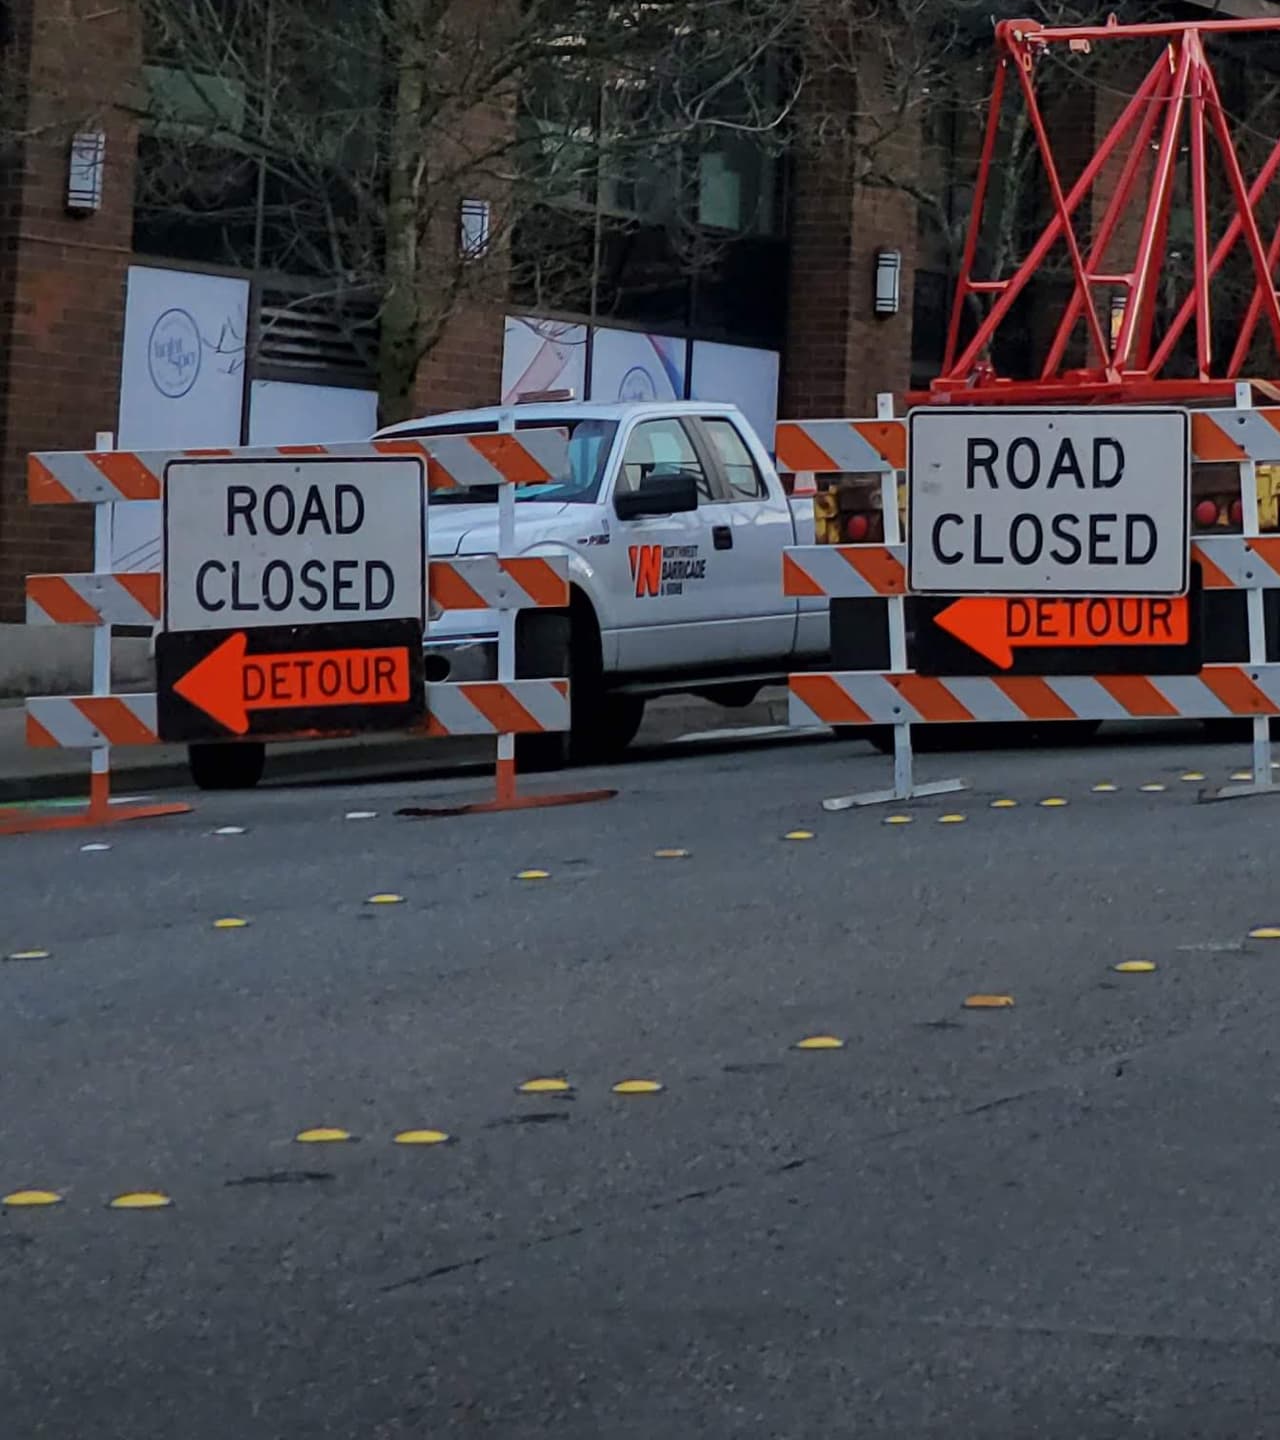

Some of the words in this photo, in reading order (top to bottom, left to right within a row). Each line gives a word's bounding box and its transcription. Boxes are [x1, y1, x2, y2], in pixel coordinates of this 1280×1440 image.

[966, 437, 1125, 490] ROAD
[227, 485, 365, 537] ROAD
[931, 513, 1158, 566] CLOSED
[195, 560, 395, 612] CLOSED
[1006, 599, 1173, 638] DETOUR
[243, 656, 397, 702] DETOUR
